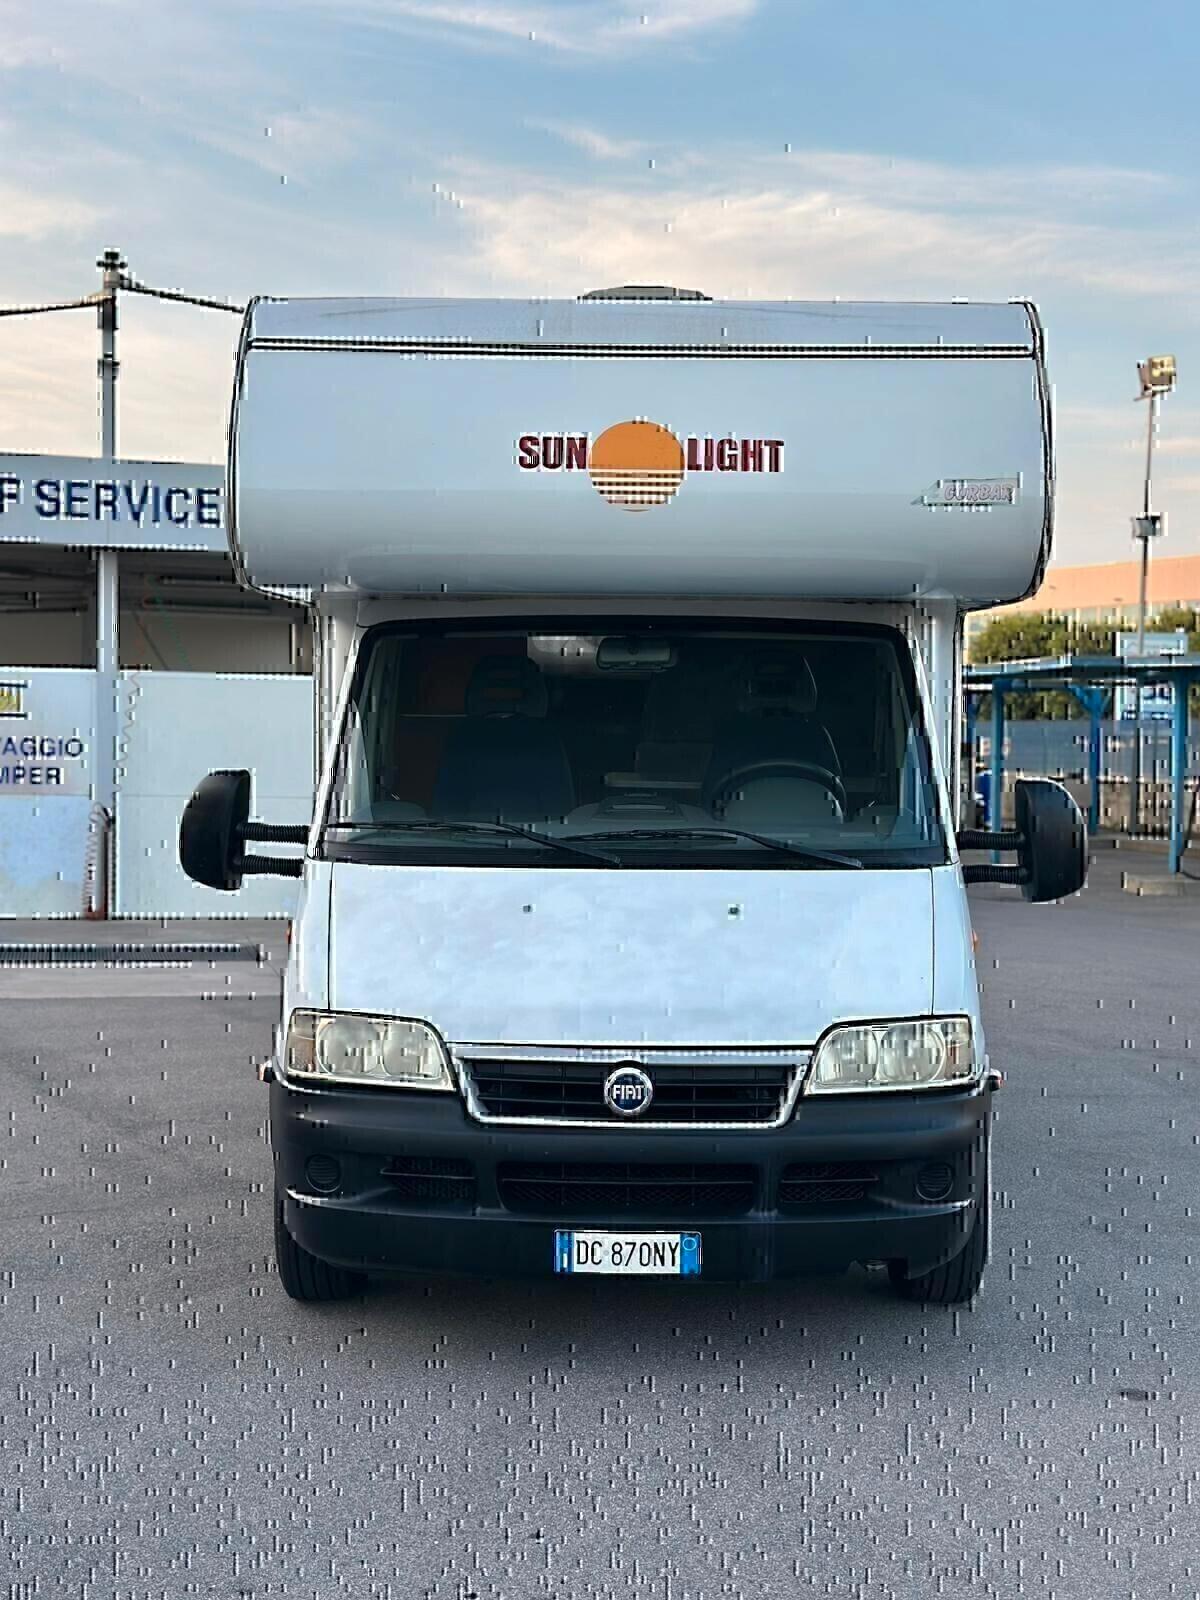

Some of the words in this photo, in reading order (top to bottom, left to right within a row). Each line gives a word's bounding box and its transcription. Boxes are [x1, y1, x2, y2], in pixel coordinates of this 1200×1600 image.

[518, 435, 588, 470] SUN
[687, 437, 785, 473] LIGHT
[35, 479, 220, 524] SERVICE
[0, 736, 83, 757] AGGIO
[613, 1084, 644, 1100] FIAT
[576, 1240, 603, 1265] DC
[611, 1241, 679, 1267] 870NY
